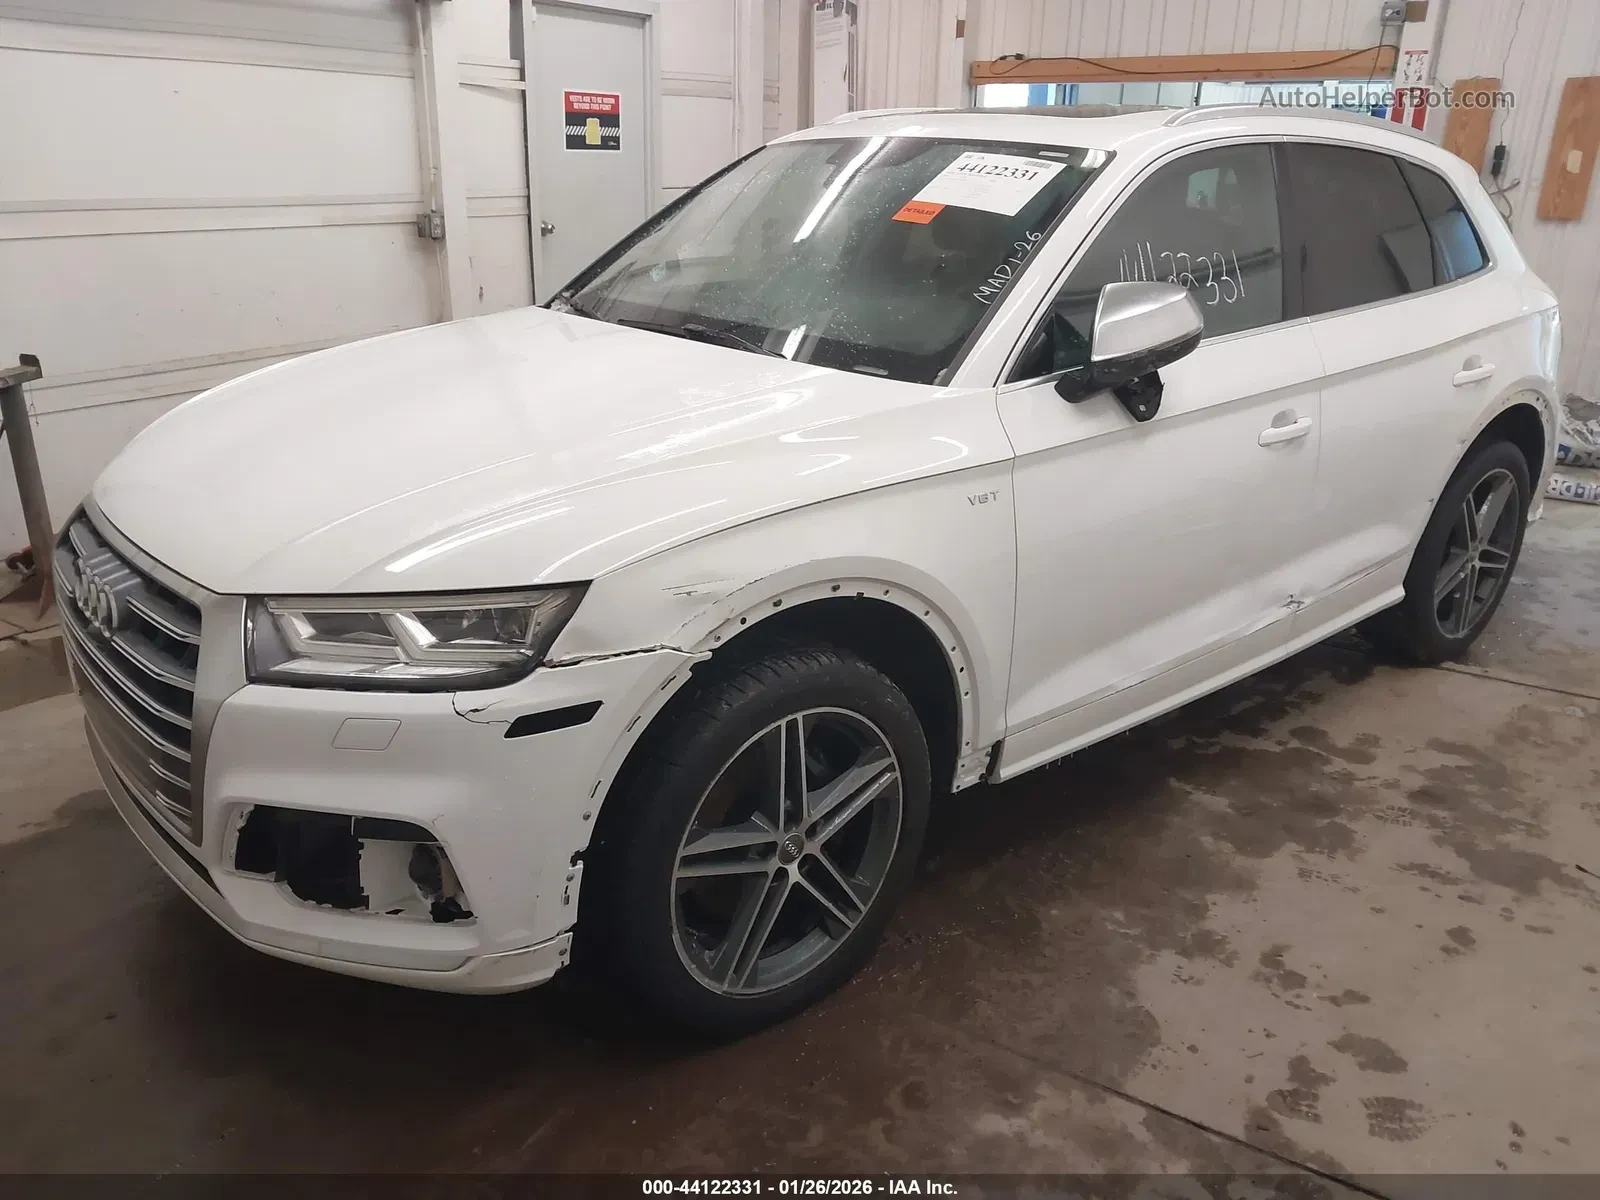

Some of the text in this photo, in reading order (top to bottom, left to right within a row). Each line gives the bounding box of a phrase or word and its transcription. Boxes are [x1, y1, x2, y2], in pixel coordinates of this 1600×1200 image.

[956, 161, 1039, 181] 44122331
[902, 207, 936, 216] DETAILED
[972, 264, 1012, 305] MAD
